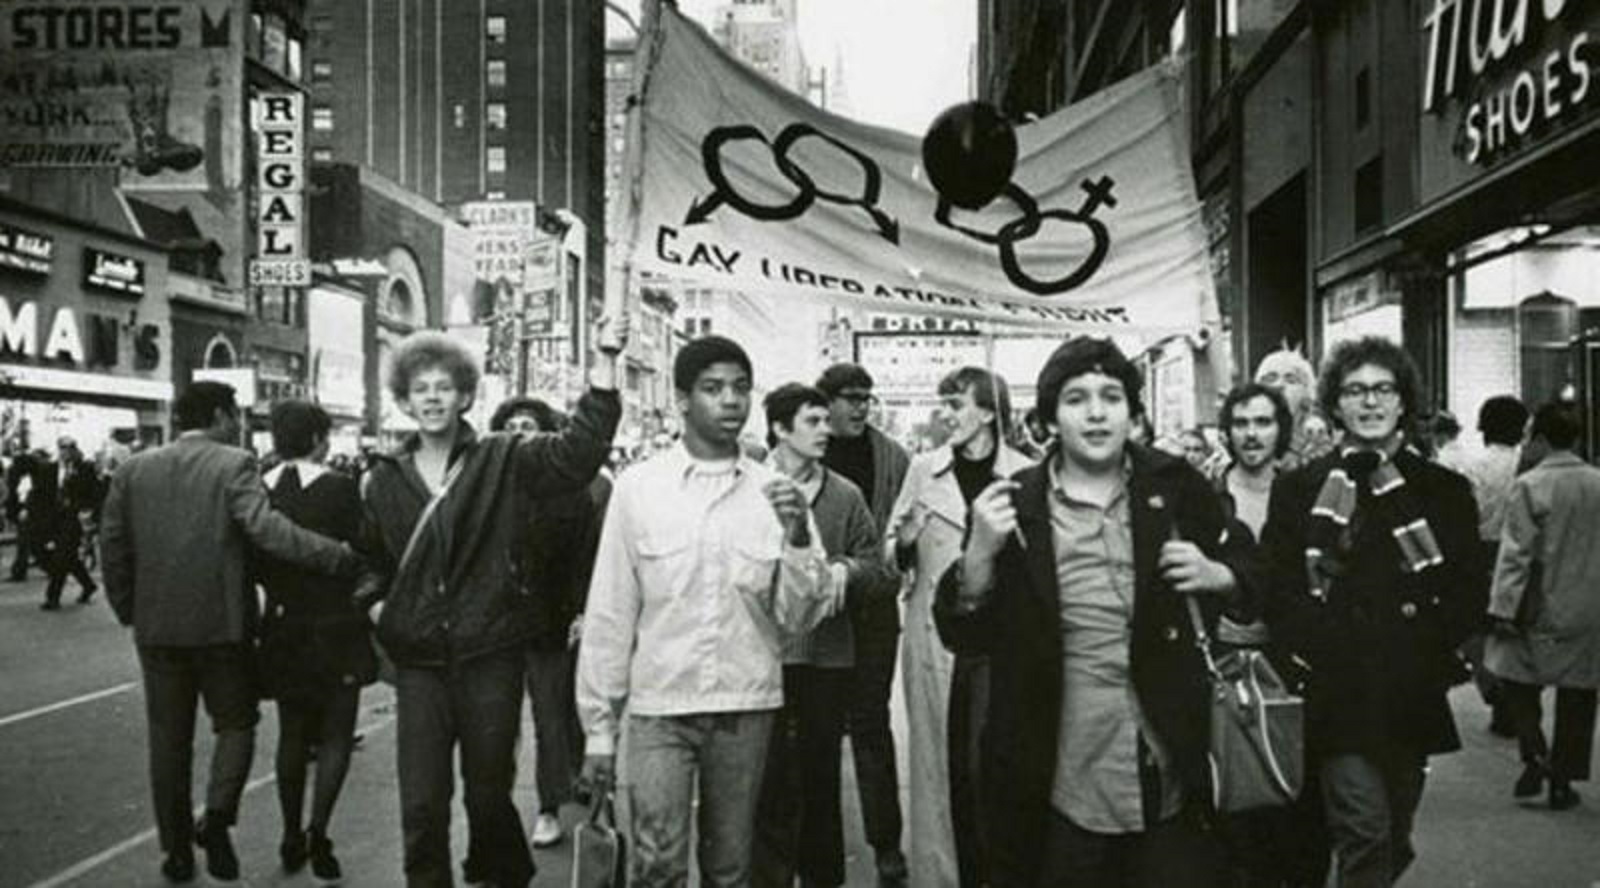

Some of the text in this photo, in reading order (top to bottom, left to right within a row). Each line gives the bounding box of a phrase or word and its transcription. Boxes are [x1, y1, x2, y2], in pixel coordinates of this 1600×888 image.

[11, 7, 182, 48] STORES
[1466, 32, 1591, 165] SHOES
[264, 96, 296, 255] REGAL
[657, 225, 741, 273] GAY
[251, 264, 305, 283] SHOES
